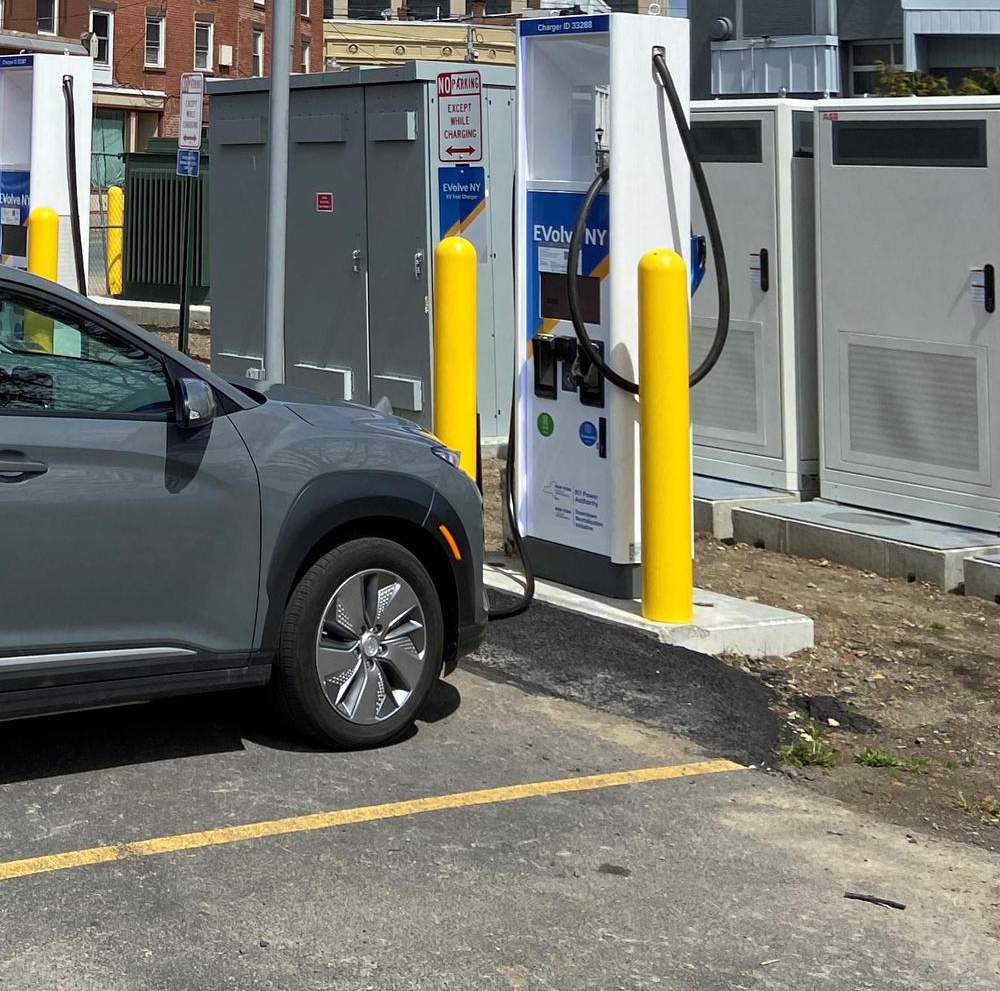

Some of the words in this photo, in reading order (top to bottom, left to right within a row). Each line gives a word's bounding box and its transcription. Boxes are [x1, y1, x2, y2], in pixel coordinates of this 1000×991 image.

[537, 23, 561, 33] Charger
[563, 22, 571, 30] ID
[438, 76, 451, 94] NO
[452, 78, 479, 90] PARKING
[447, 103, 472, 113] EXCEPT
[450, 116, 471, 126] WHILE
[443, 129, 477, 139] CHARGING
[442, 183, 469, 192] EVolve
[469, 183, 481, 192] NY
[0, 192, 21, 206] EVolve
[534, 224, 574, 244] EVolv
[584, 228, 607, 246] NY
